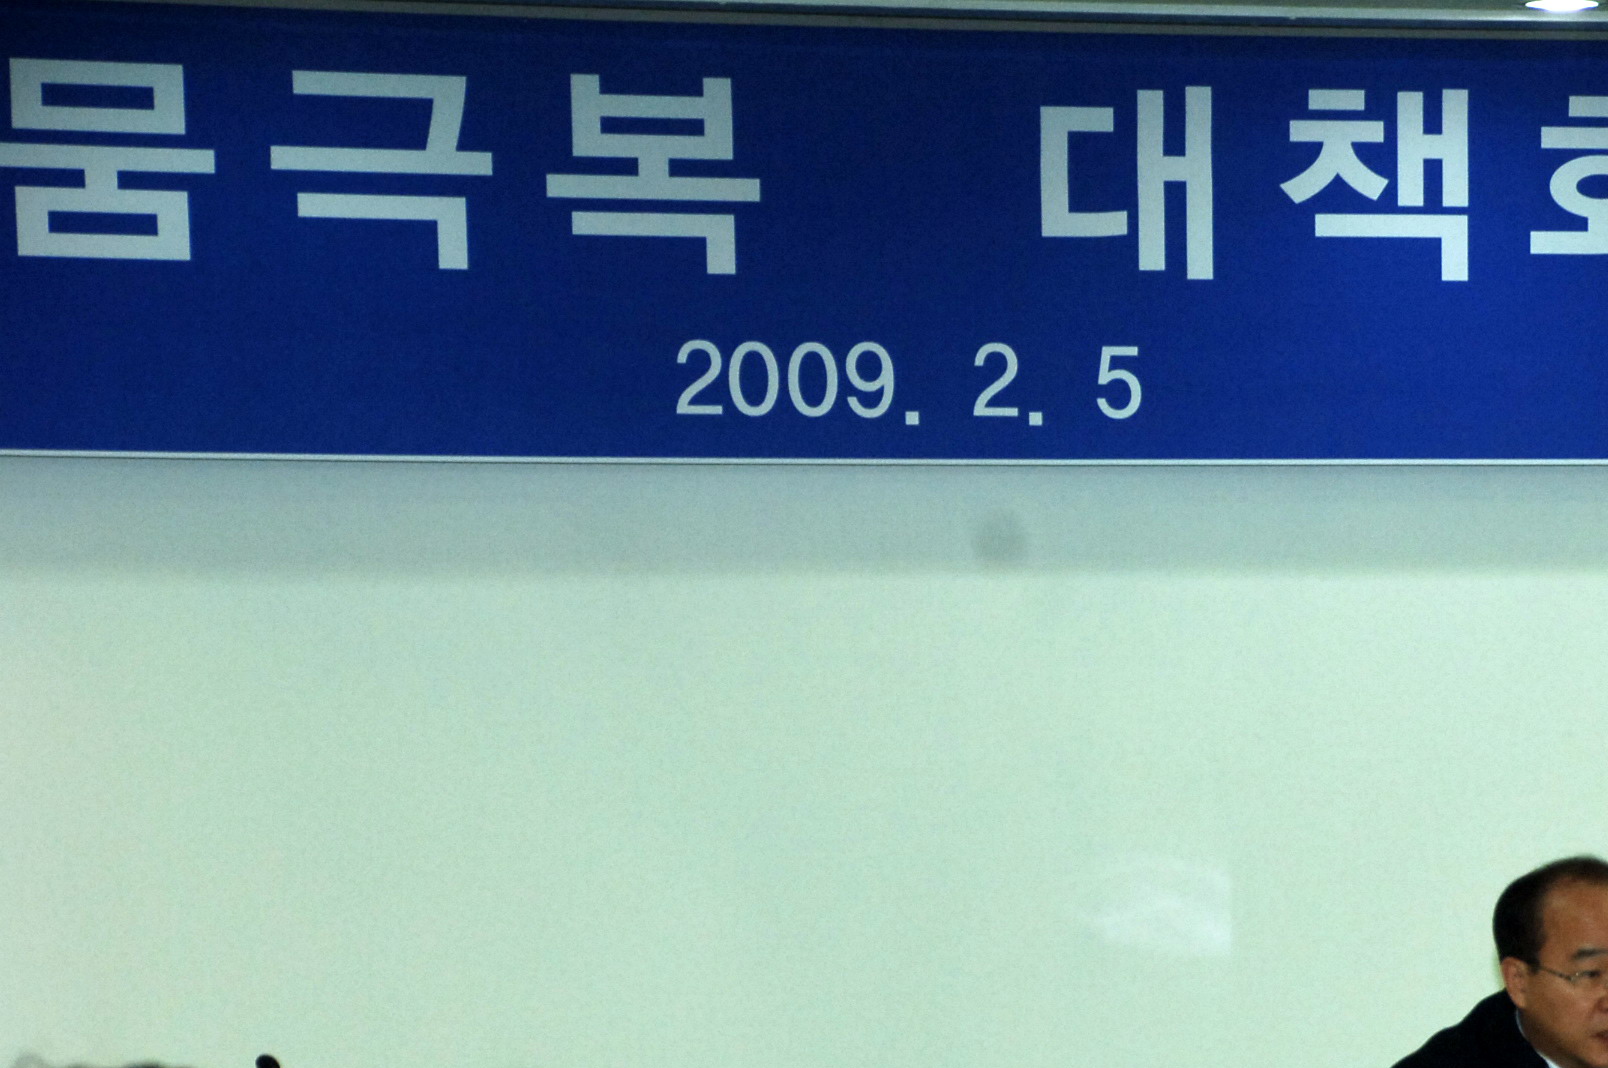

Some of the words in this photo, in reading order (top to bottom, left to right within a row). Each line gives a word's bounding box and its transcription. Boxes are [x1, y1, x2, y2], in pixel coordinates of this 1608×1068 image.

[676, 339, 920, 426] 2009.
[973, 342, 1043, 426] 2.
[1096, 346, 1142, 420] 5
